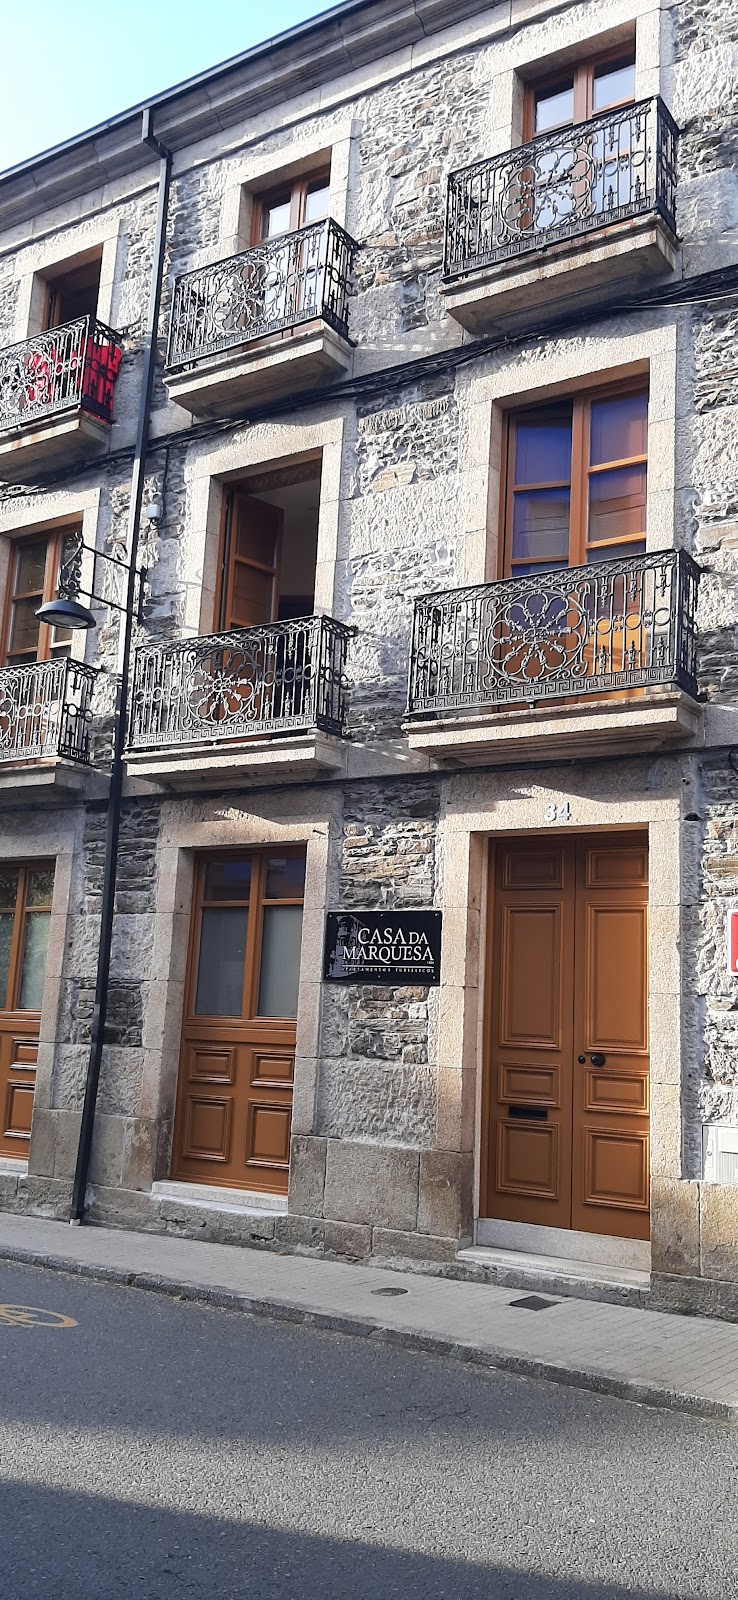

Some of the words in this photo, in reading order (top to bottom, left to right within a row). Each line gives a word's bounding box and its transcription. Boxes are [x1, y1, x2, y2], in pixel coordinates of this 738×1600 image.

[543, 801, 572, 821] 34
[357, 928, 407, 944] CASA
[408, 931, 429, 944] DA
[342, 945, 435, 964] MARQUESA
